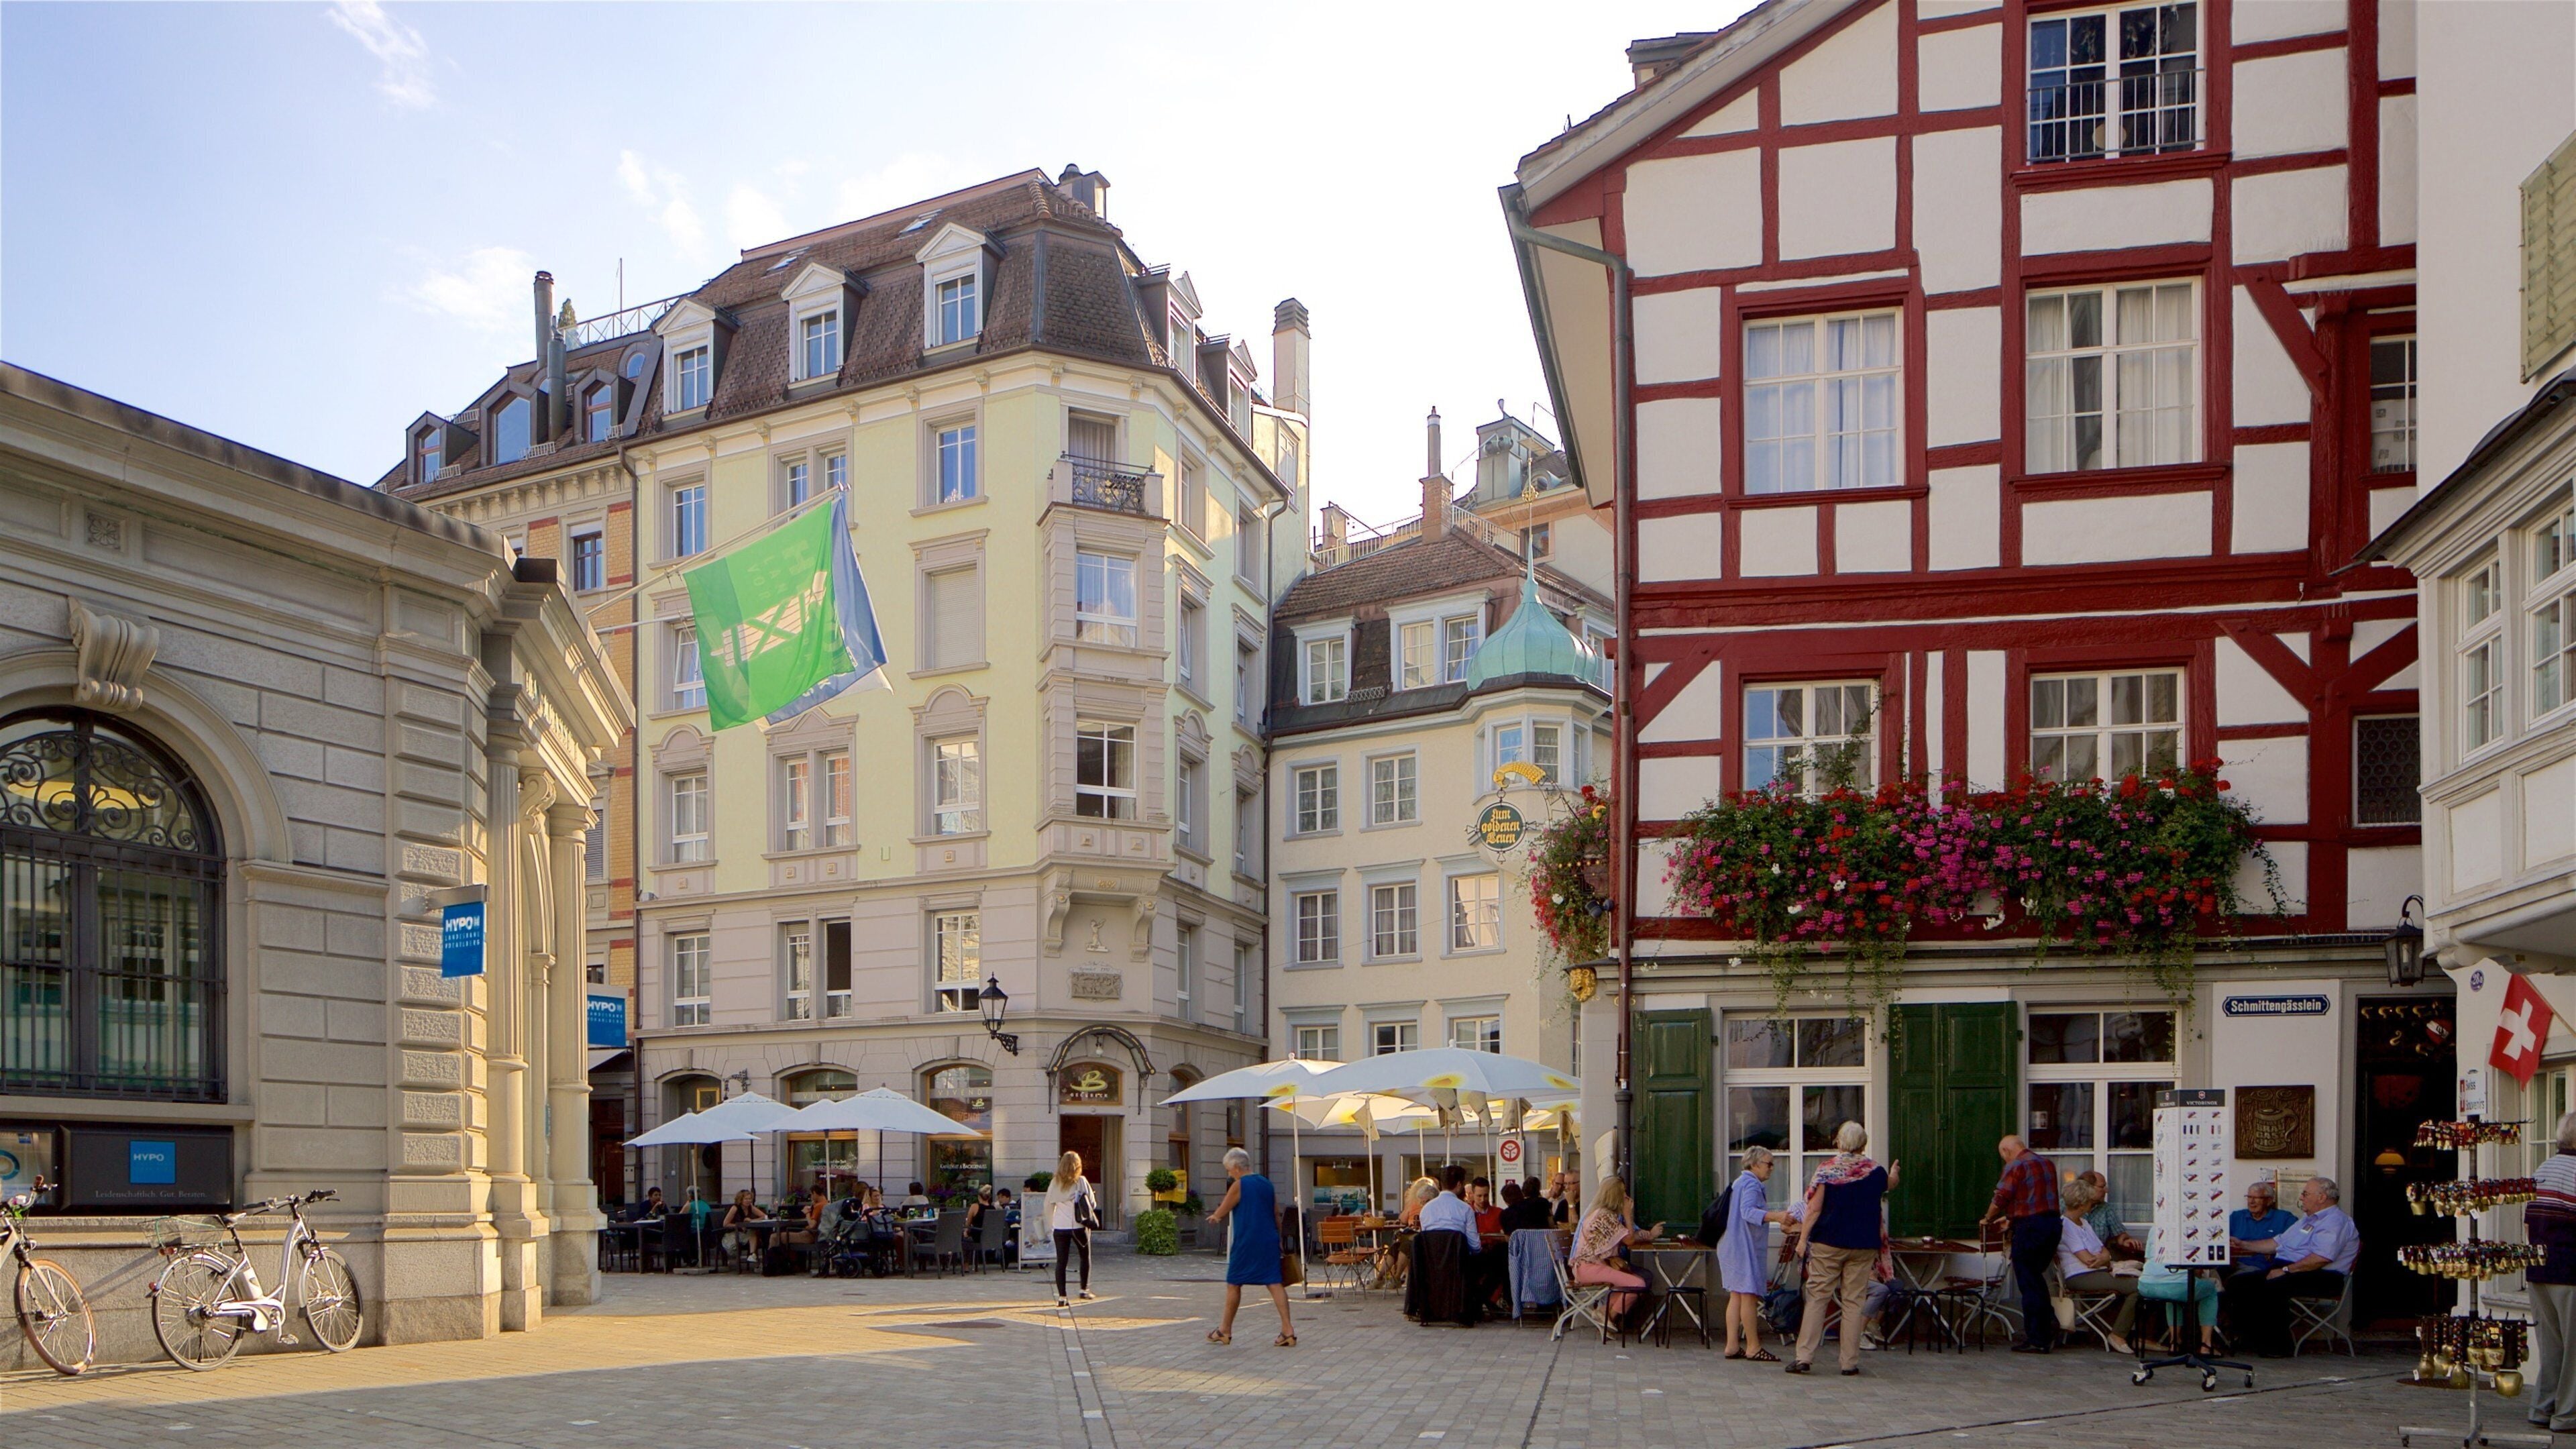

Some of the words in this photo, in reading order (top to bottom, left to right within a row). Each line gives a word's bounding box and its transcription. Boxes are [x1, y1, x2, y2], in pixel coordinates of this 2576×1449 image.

[1481, 819, 1521, 833] goldenen
[445, 916, 474, 932] HYPO
[588, 1000, 616, 1012] HYPO
[2231, 999, 2322, 1014] Schmittengässlein
[802, 1091, 850, 1099] VIVNDI
[938, 1089, 988, 1097] VIVENDI
[133, 1153, 165, 1162] HYPO
[96, 1190, 157, 1198] Leidenschaftlich.
